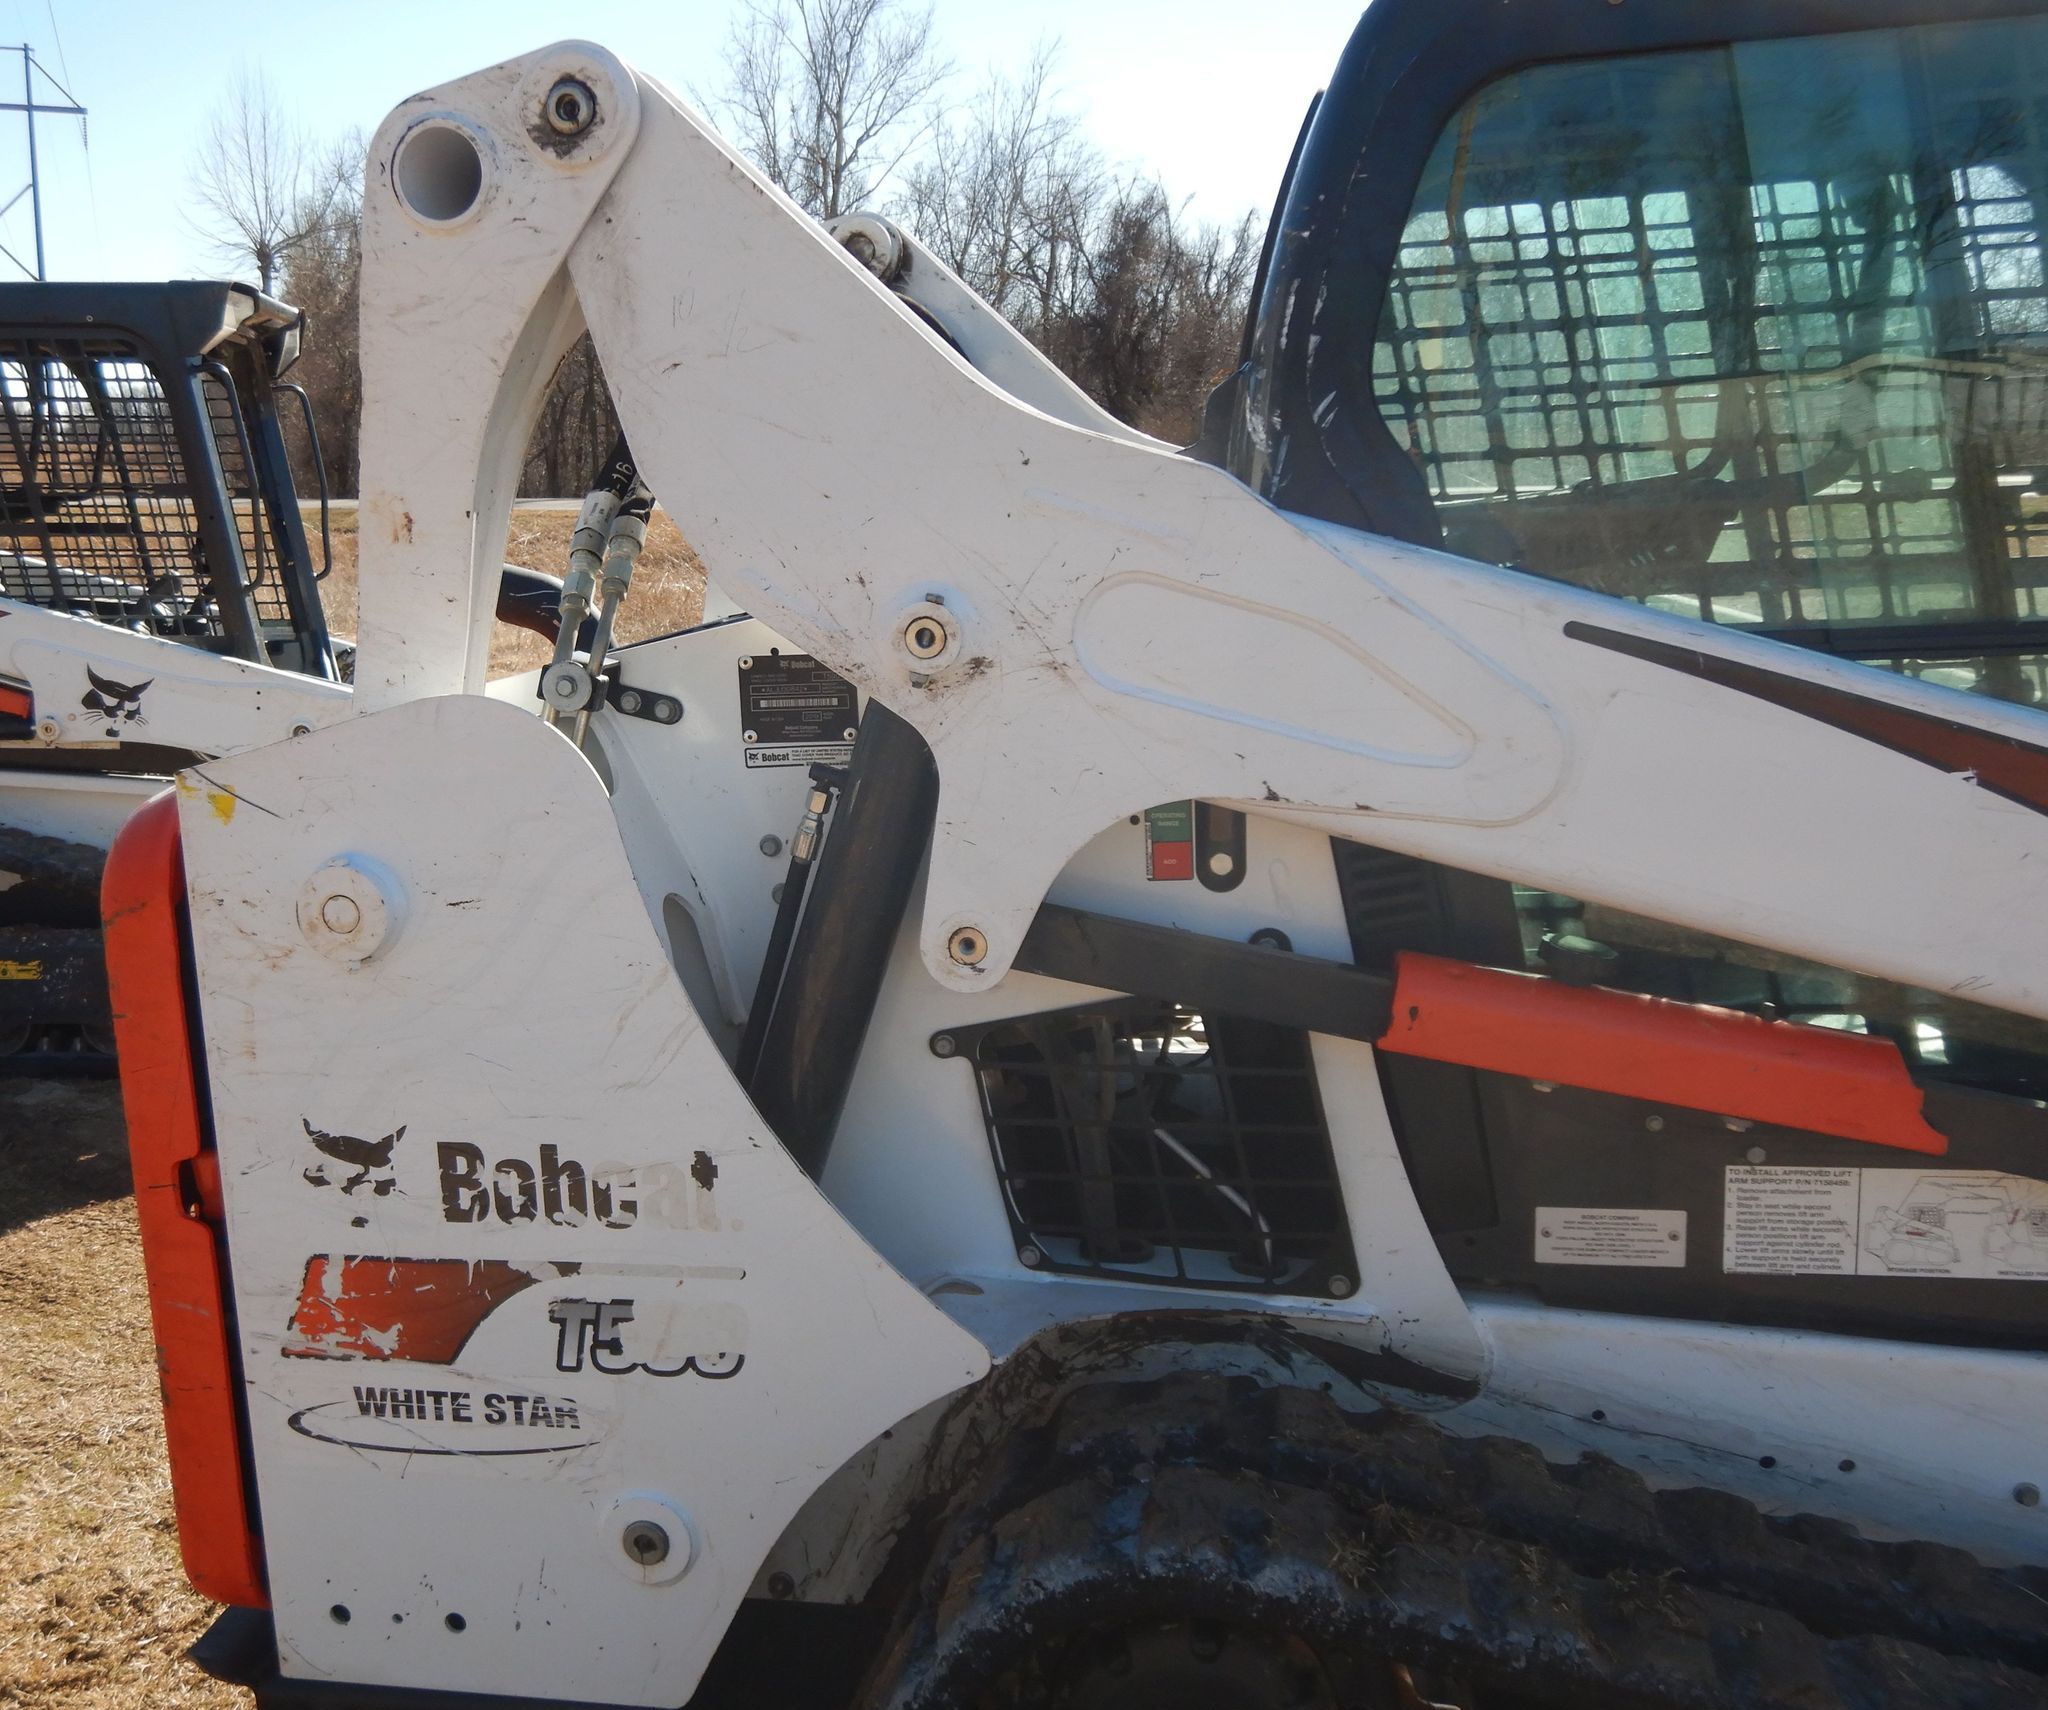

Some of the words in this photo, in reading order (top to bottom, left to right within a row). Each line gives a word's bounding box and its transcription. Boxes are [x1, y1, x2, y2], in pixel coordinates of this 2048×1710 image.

[762, 752, 790, 762] Bobcat
[352, 1385, 473, 1423] WHITE
[484, 1393, 581, 1430] STAR
